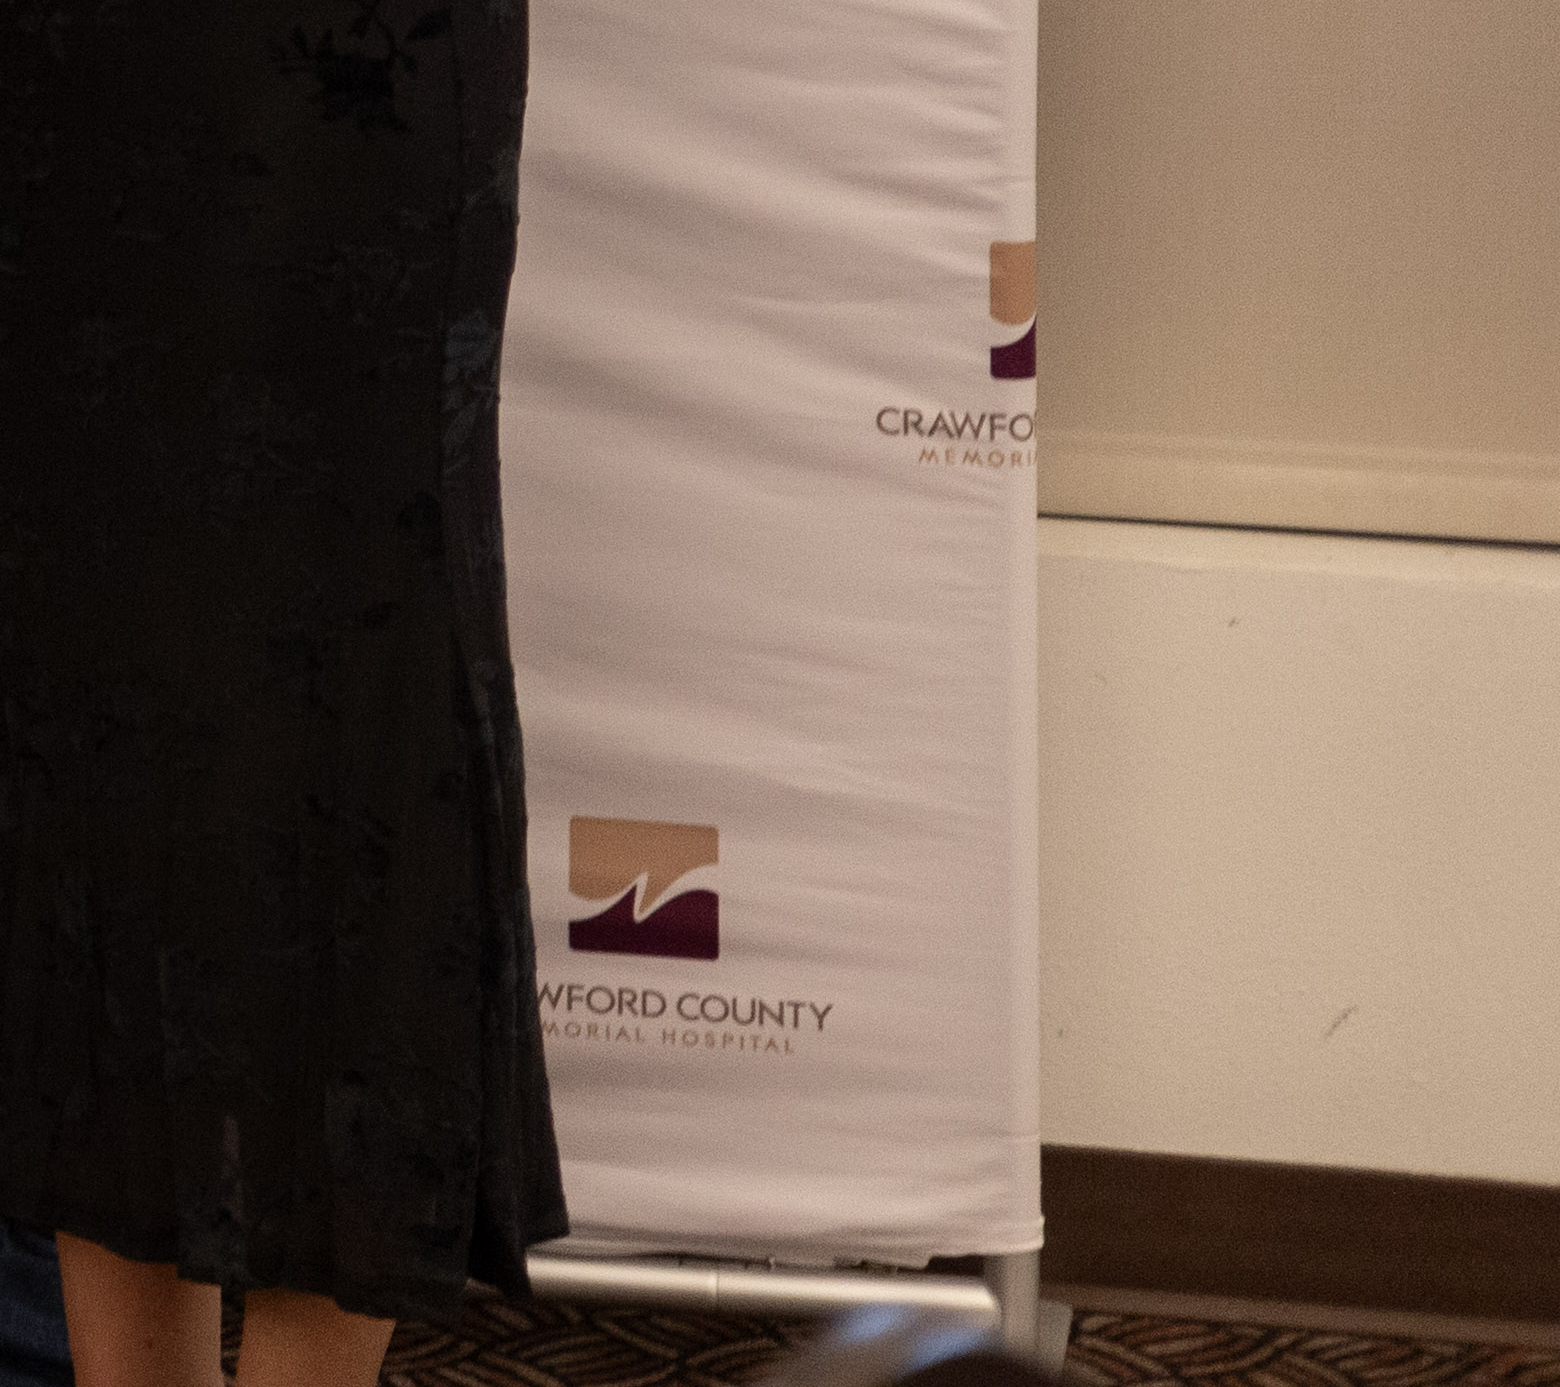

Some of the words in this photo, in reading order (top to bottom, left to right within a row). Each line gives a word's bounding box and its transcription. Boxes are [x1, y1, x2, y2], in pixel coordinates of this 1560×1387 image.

[876, 406, 1034, 442] CRAWFO
[918, 447, 1033, 469] MEMORI
[537, 981, 667, 1019] WFORD
[676, 991, 834, 1032] COUNTY
[542, 1020, 643, 1045] MORIAL
[661, 1027, 793, 1055] HOSPITAL
